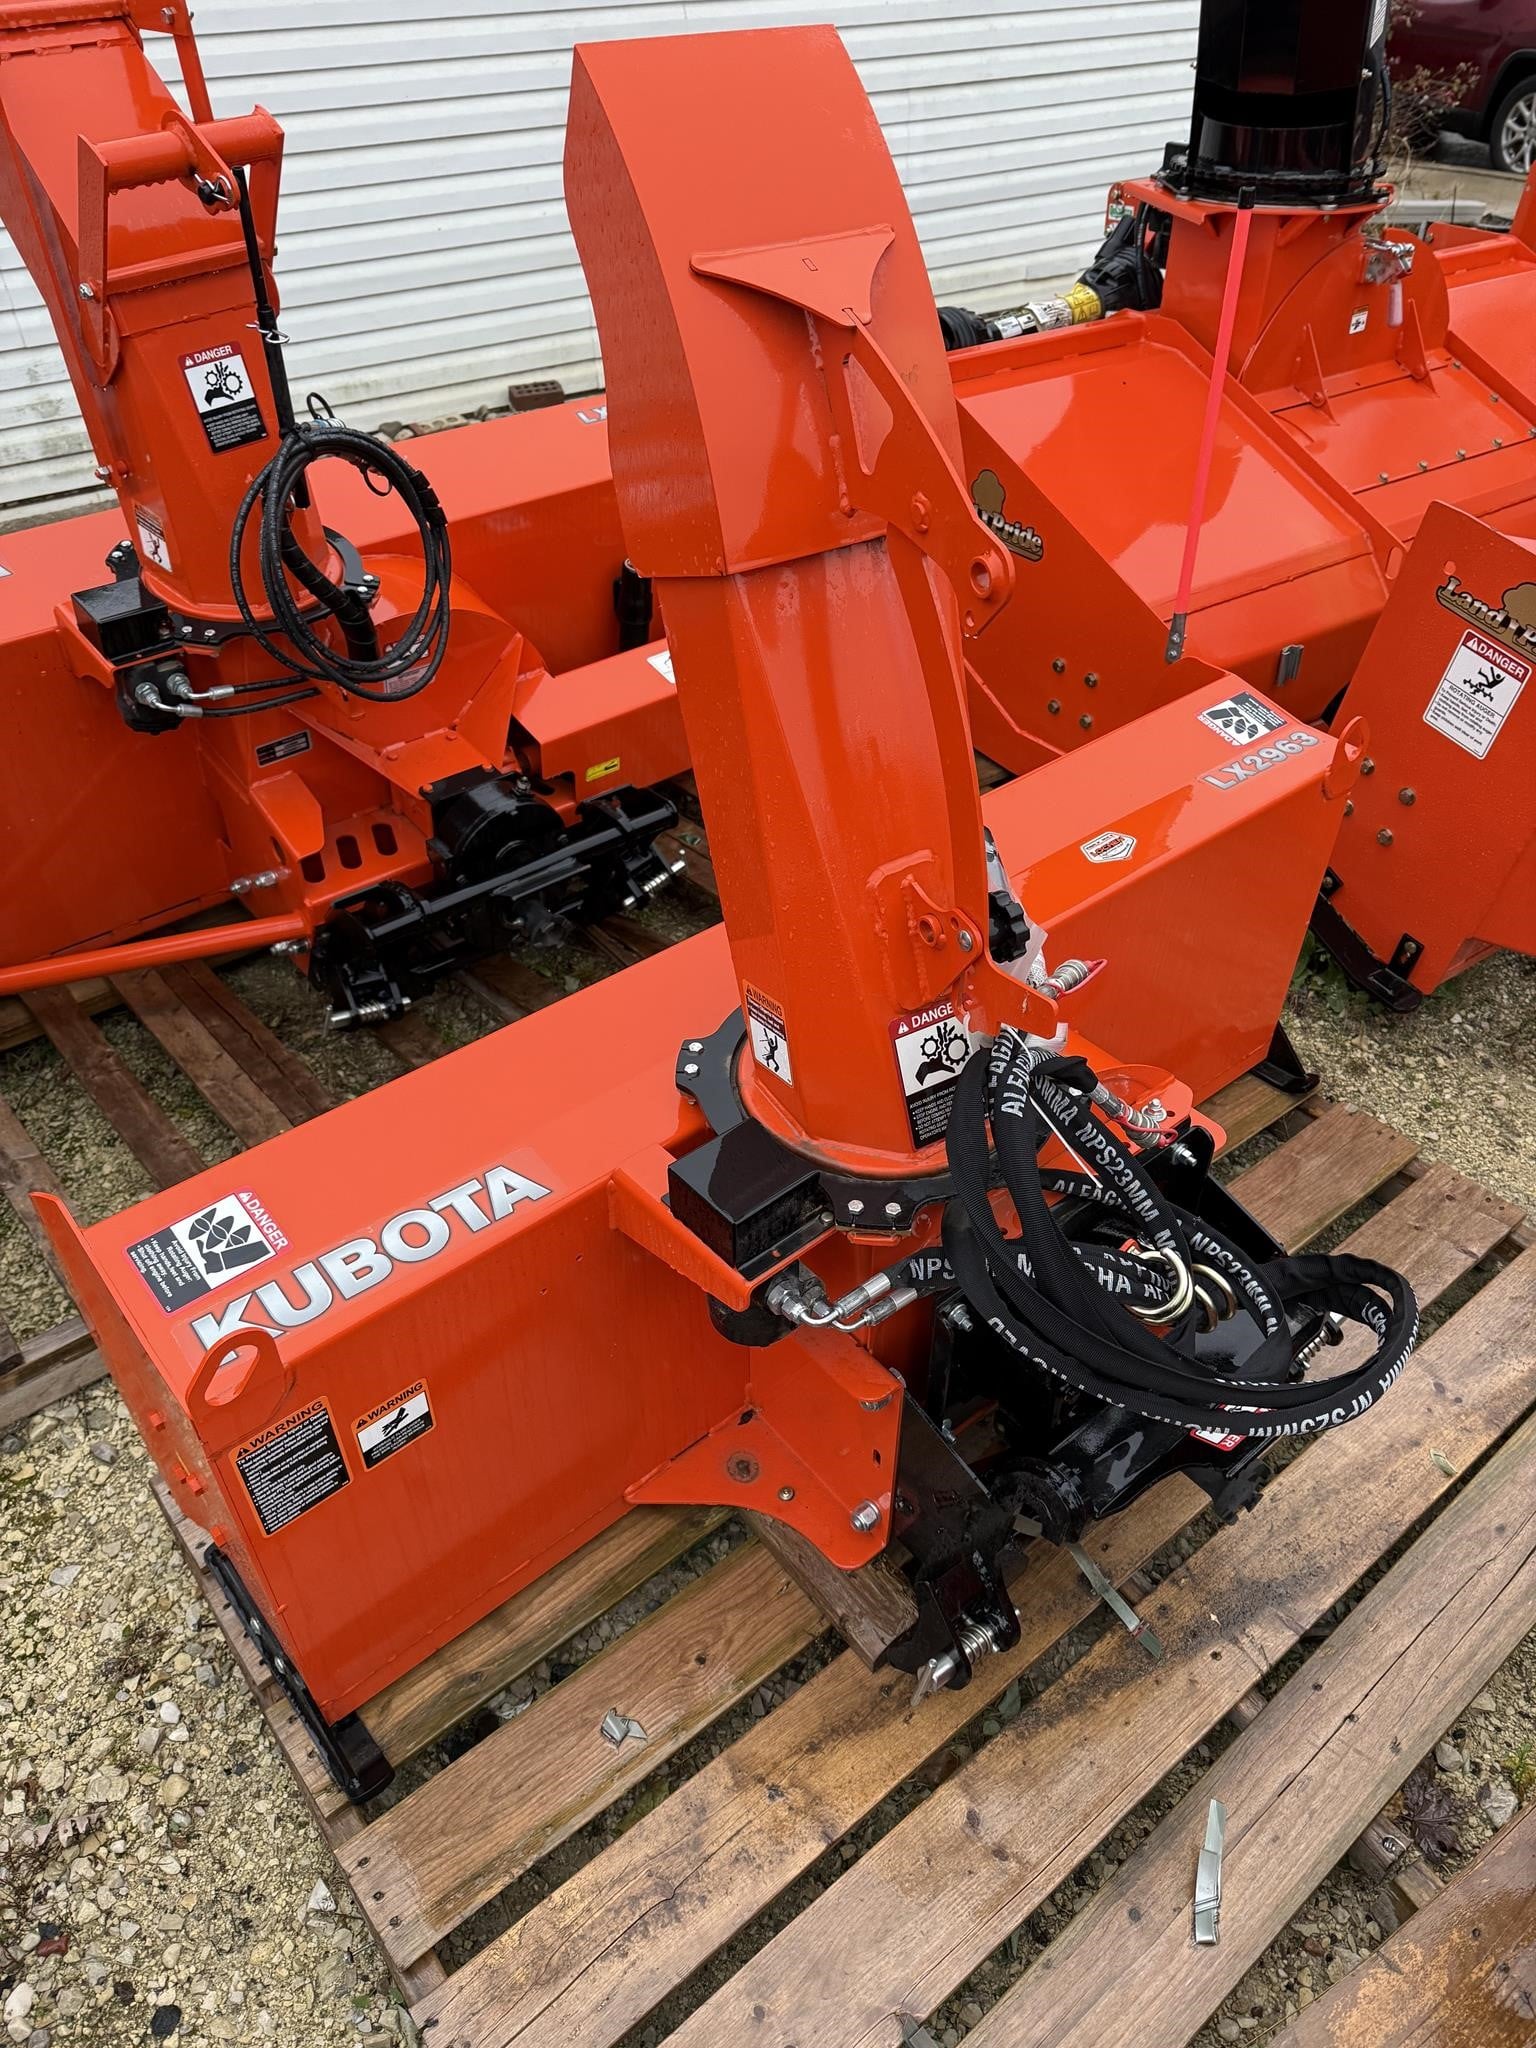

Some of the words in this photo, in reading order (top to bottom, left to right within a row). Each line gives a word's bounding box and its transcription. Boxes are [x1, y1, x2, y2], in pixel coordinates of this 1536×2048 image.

[194, 345, 233, 363] DANGER
[991, 512, 1042, 552] Pride
[1441, 576, 1509, 634] Land
[1478, 643, 1525, 679] DANGER
[1448, 684, 1476, 705] ROTATING
[1475, 702, 1495, 718] AUGER
[1203, 731, 1319, 790] LX2963
[911, 1002, 954, 1029] DANGE
[1075, 1121, 1160, 1222] NPS23MM
[246, 1199, 288, 1251] DANGER
[142, 1243, 159, 1264] clothing
[149, 1239, 162, 1253] Keep
[174, 1275, 185, 1286] and
[164, 1245, 183, 1267] Rotating
[171, 1238, 184, 1254] Avoid
[189, 1266, 201, 1281] From
[191, 1165, 552, 1366] KUBOTA
[147, 1264, 162, 1282] engine
[159, 1280, 173, 1298] before
[368, 1383, 423, 1420] WARNING
[250, 1401, 323, 1448] WARNING
